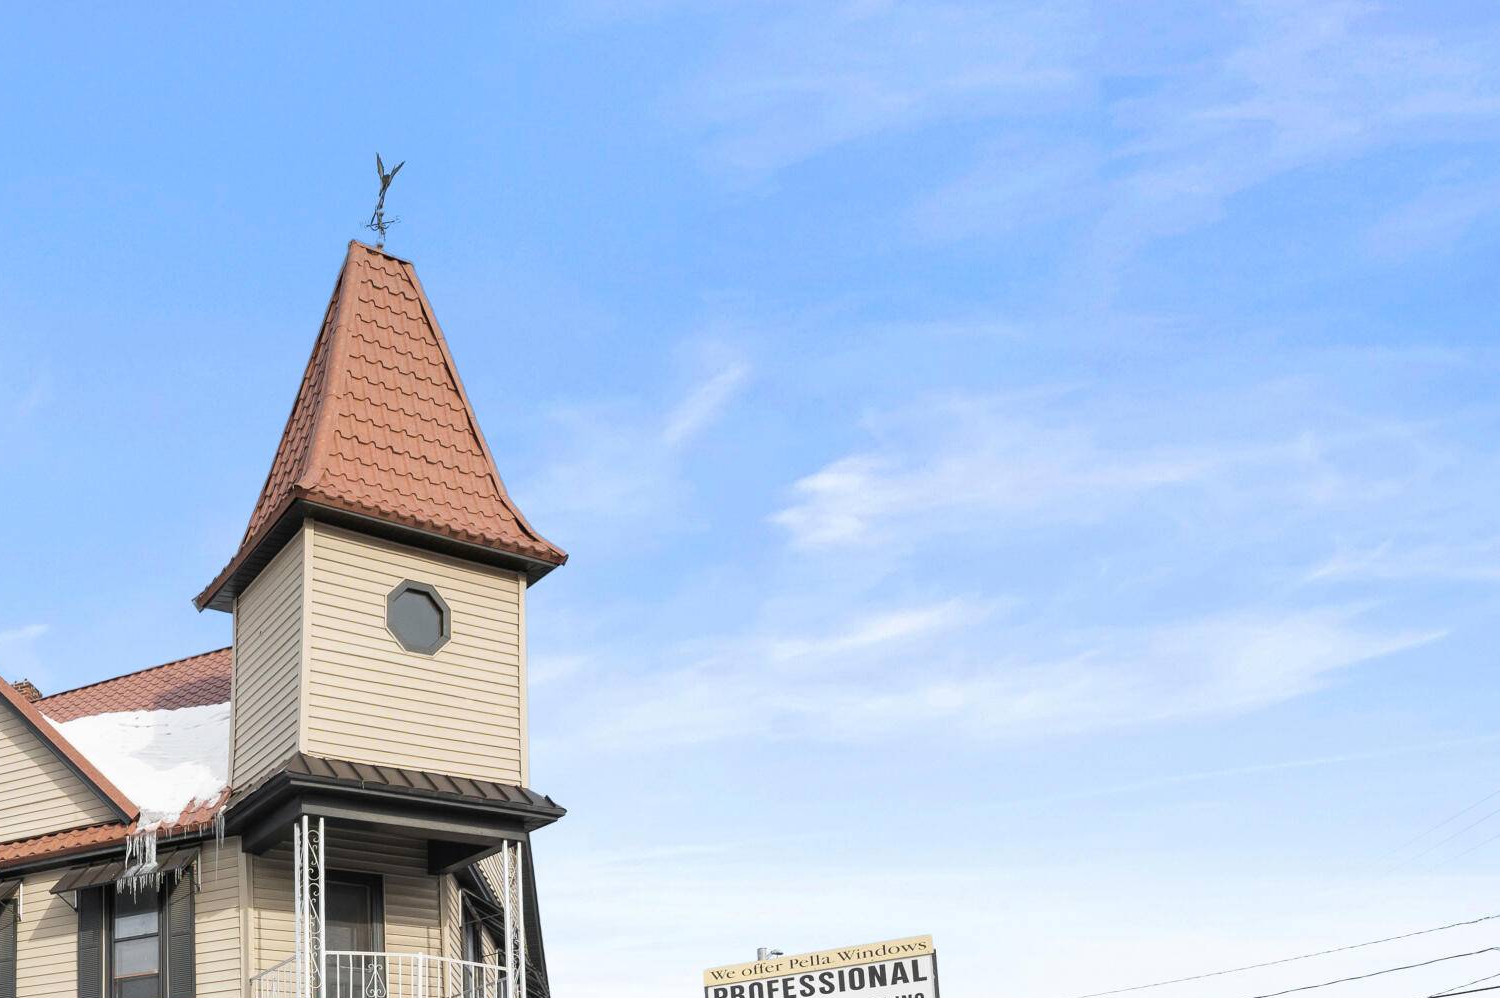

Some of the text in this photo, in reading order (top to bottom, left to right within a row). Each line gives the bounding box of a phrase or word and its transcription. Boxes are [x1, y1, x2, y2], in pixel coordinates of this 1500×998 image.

[711, 942, 927, 981] We offer Pella Windows
